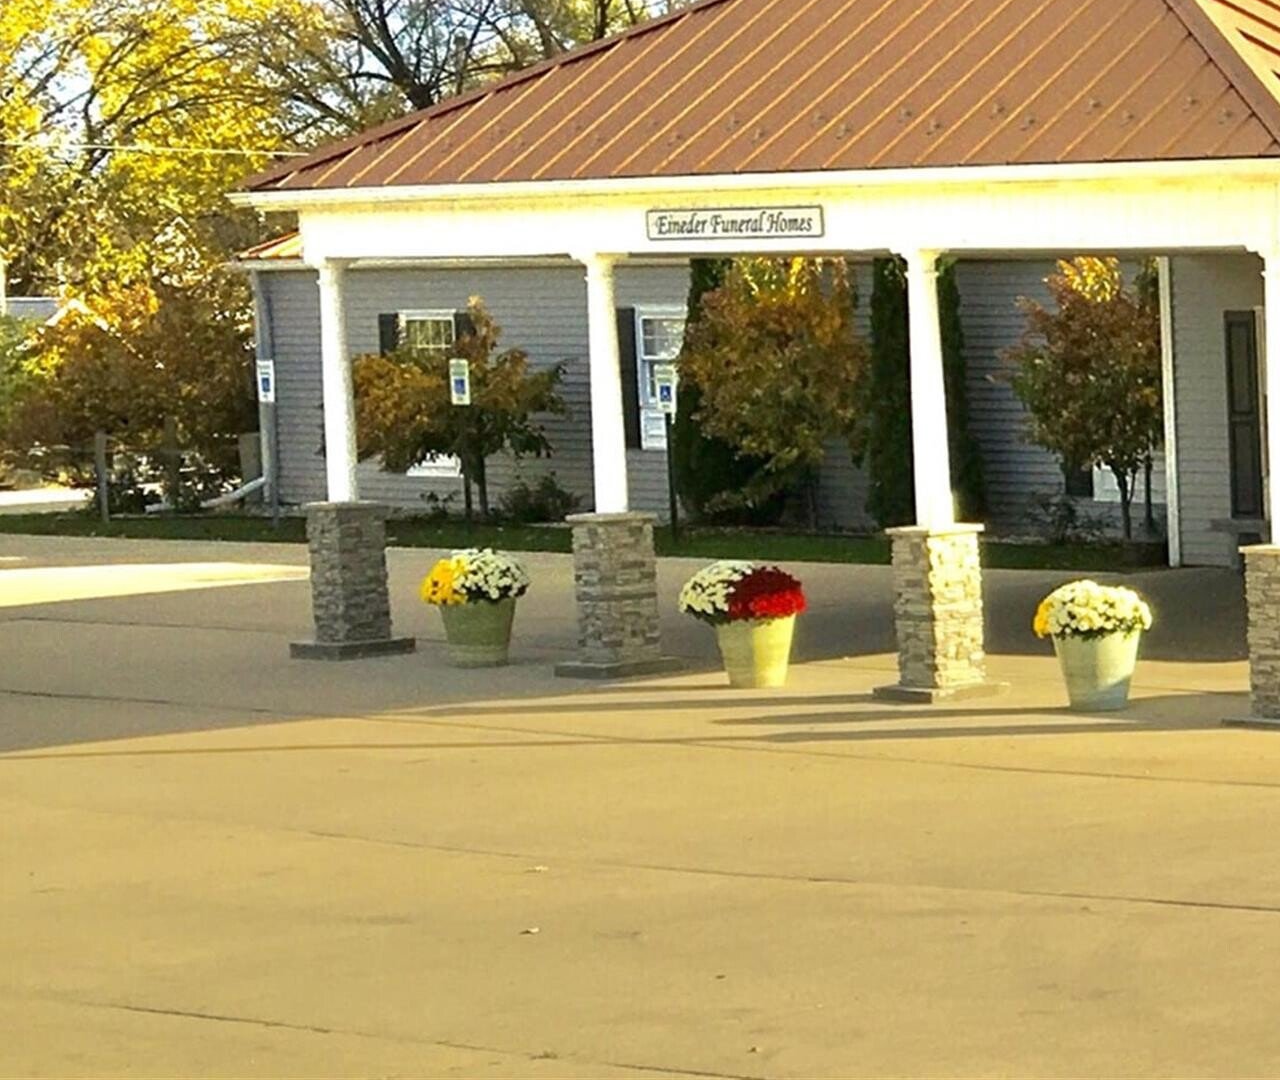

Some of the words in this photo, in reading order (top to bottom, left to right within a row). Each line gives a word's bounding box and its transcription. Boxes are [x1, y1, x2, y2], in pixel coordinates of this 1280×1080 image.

[656, 213, 707, 235] Eineder
[710, 211, 764, 233] Funeral
[766, 211, 813, 233] Homes
